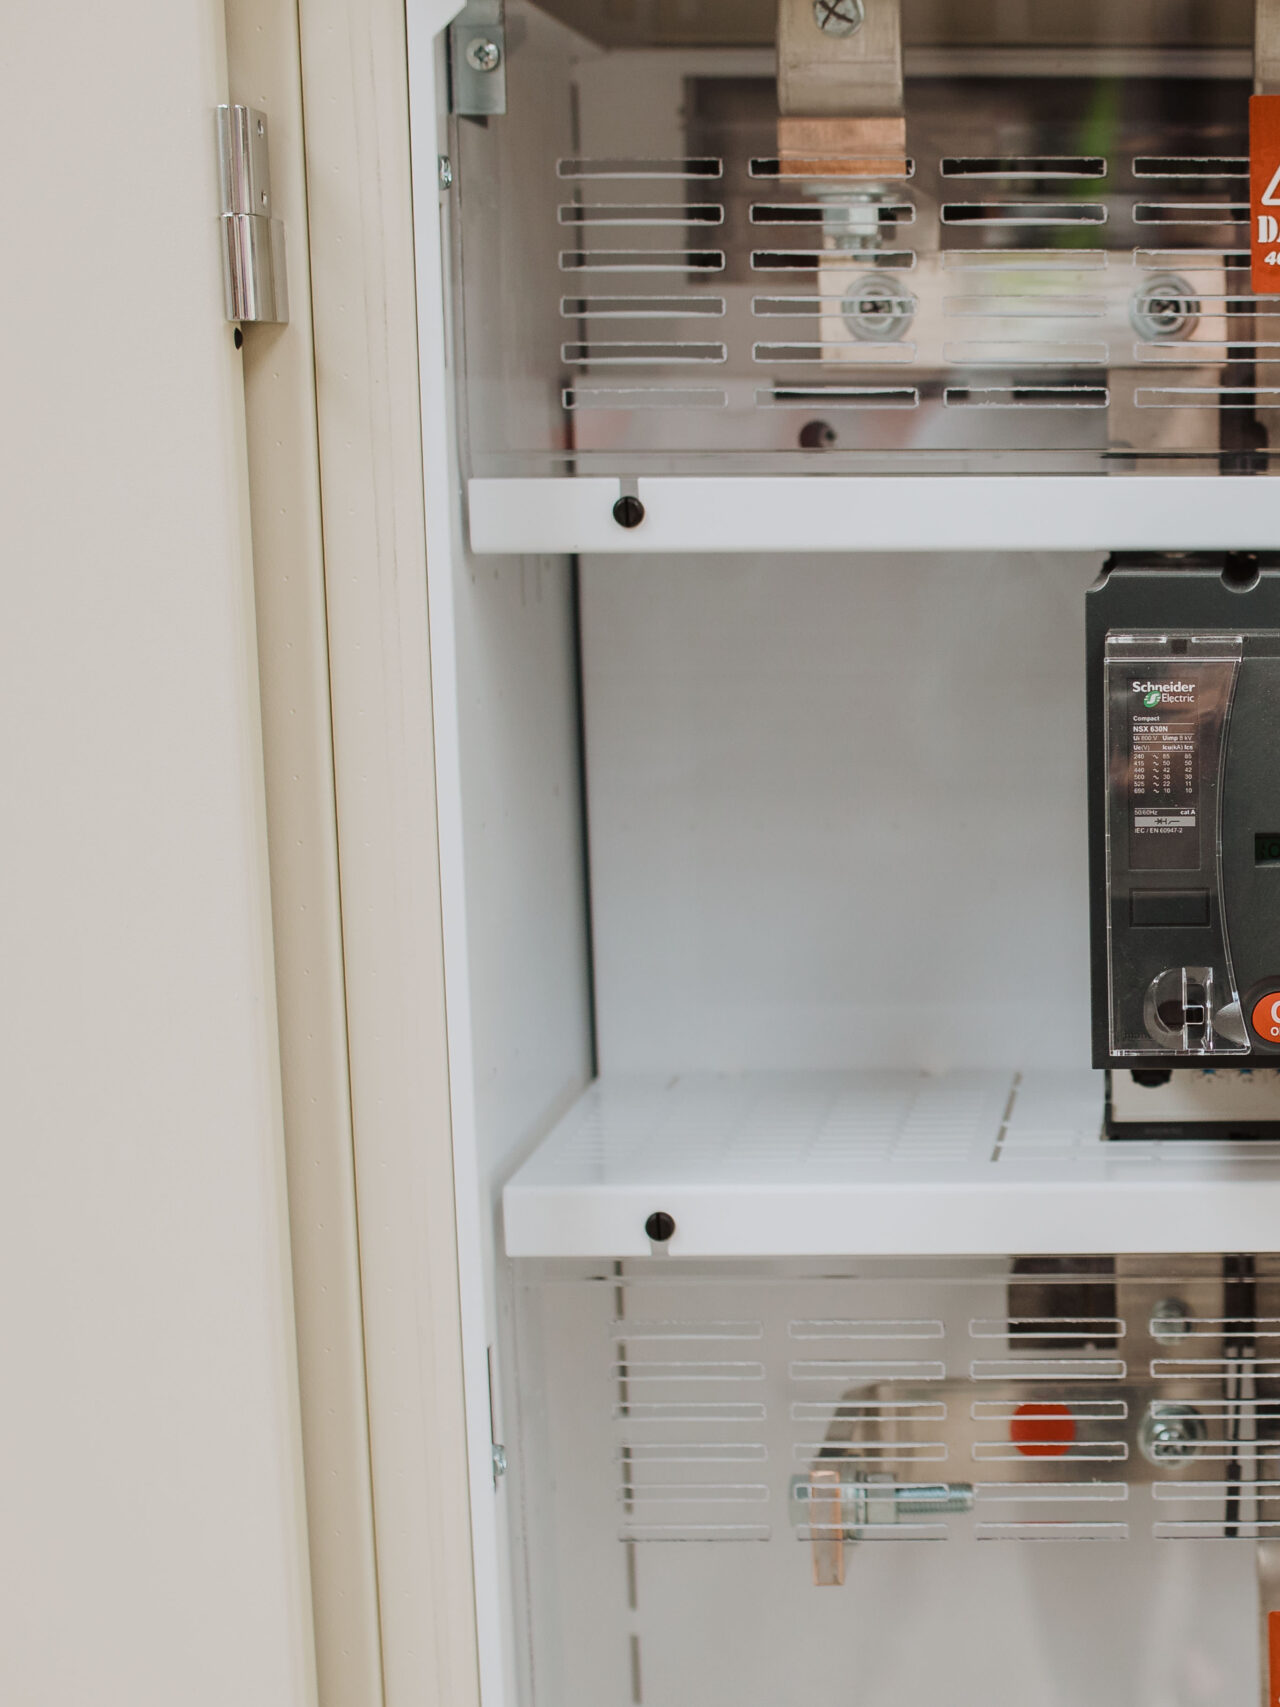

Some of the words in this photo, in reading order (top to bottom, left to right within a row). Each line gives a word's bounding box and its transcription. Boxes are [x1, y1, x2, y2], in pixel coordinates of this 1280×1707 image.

[1132, 681, 1195, 693] Schneider
[1161, 693, 1195, 703] Electric
[1133, 715, 1160, 723] Compact
[1133, 725, 1149, 733] NSX
[1150, 725, 1168, 733] 630N
